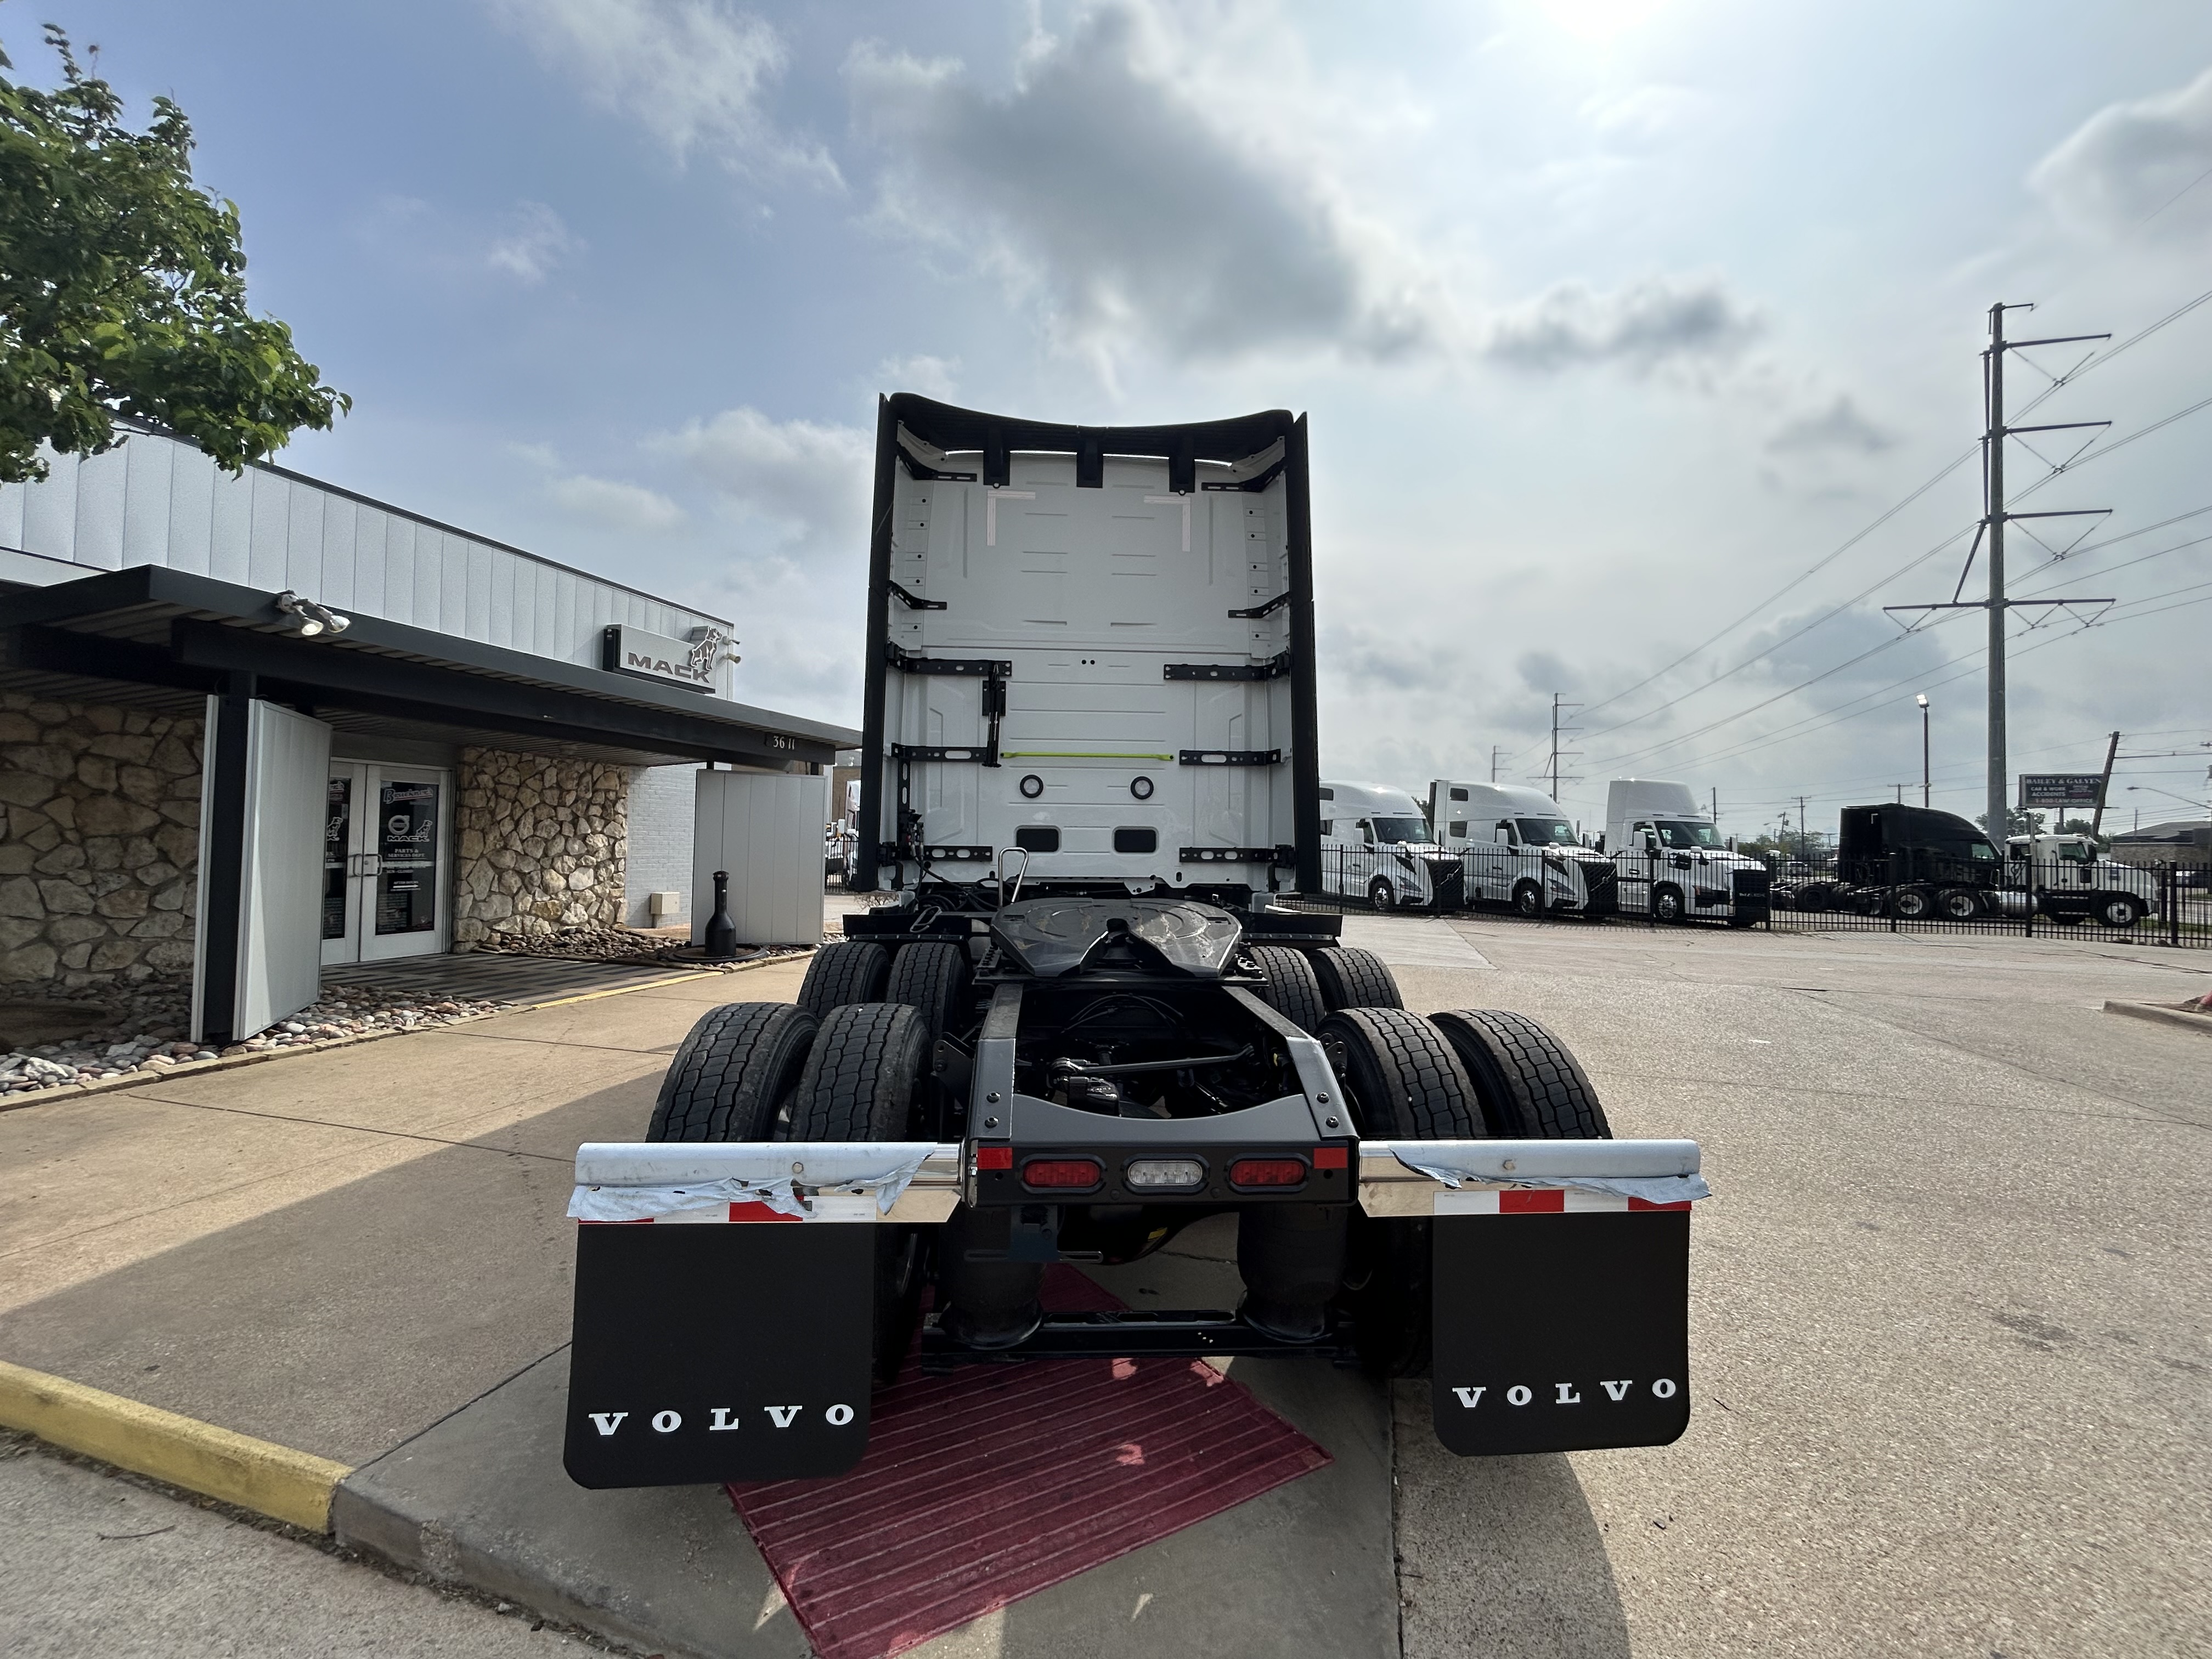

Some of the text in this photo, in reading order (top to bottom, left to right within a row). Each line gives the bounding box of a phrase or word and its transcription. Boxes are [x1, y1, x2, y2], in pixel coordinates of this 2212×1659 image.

[628, 652, 710, 684] MACK
[1452, 1378, 1677, 1408] VOLVO
[588, 1404, 854, 1436] VOLVO
